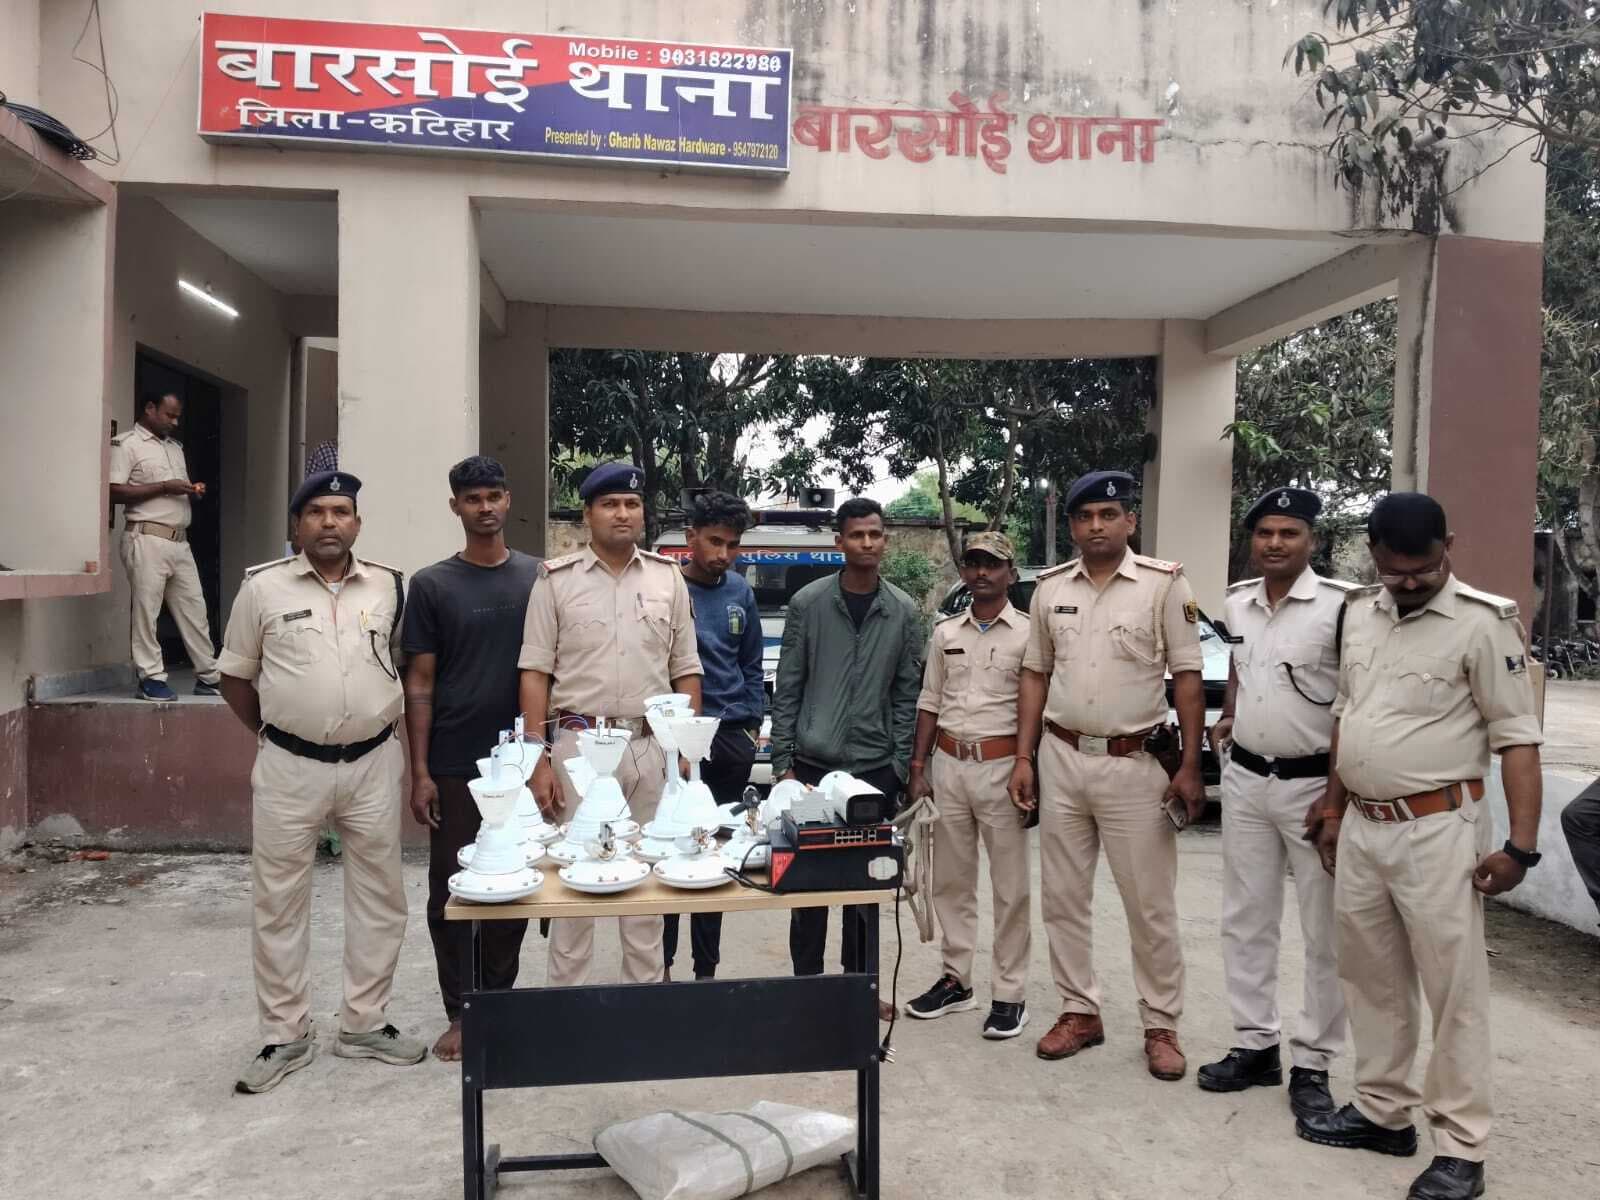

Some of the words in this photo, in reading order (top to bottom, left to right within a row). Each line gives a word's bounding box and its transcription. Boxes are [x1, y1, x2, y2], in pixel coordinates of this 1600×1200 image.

[568, 42, 639, 60] Mobile
[215, 32, 539, 113] बारसोई
[568, 62, 782, 120] थाना
[545, 126, 589, 146] Presented
[590, 130, 602, 151] by
[608, 131, 641, 150] Gharib
[643, 134, 677, 152] Nawaz
[678, 136, 726, 156] Hardware
[791, 90, 1017, 174] बारसोई
[1027, 113, 1165, 164] थाना
[741, 550, 799, 563] पुलिस
[809, 551, 847, 562] थान
